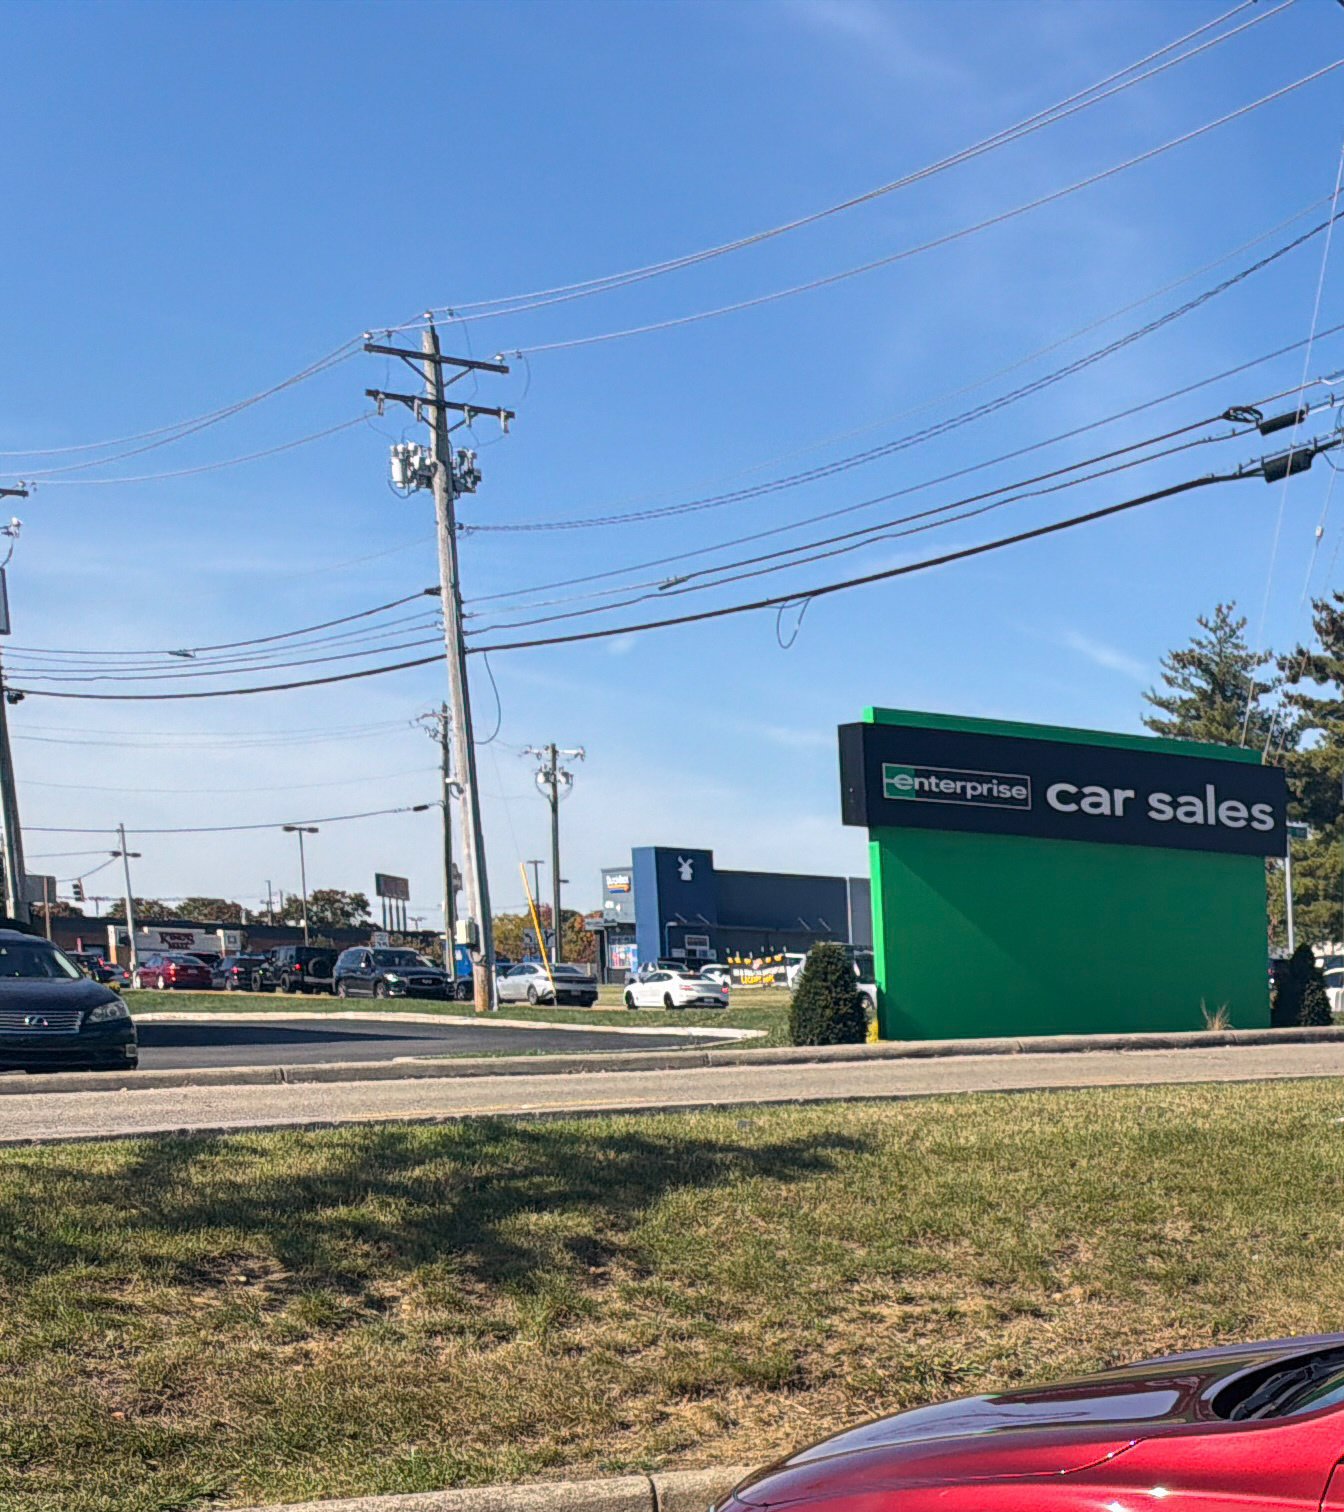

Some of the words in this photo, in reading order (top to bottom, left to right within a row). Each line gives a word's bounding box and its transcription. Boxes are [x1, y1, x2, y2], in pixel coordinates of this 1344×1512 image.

[889, 772, 1028, 800] enterprise
[1046, 782, 1135, 816] car
[1148, 784, 1275, 832] sales
